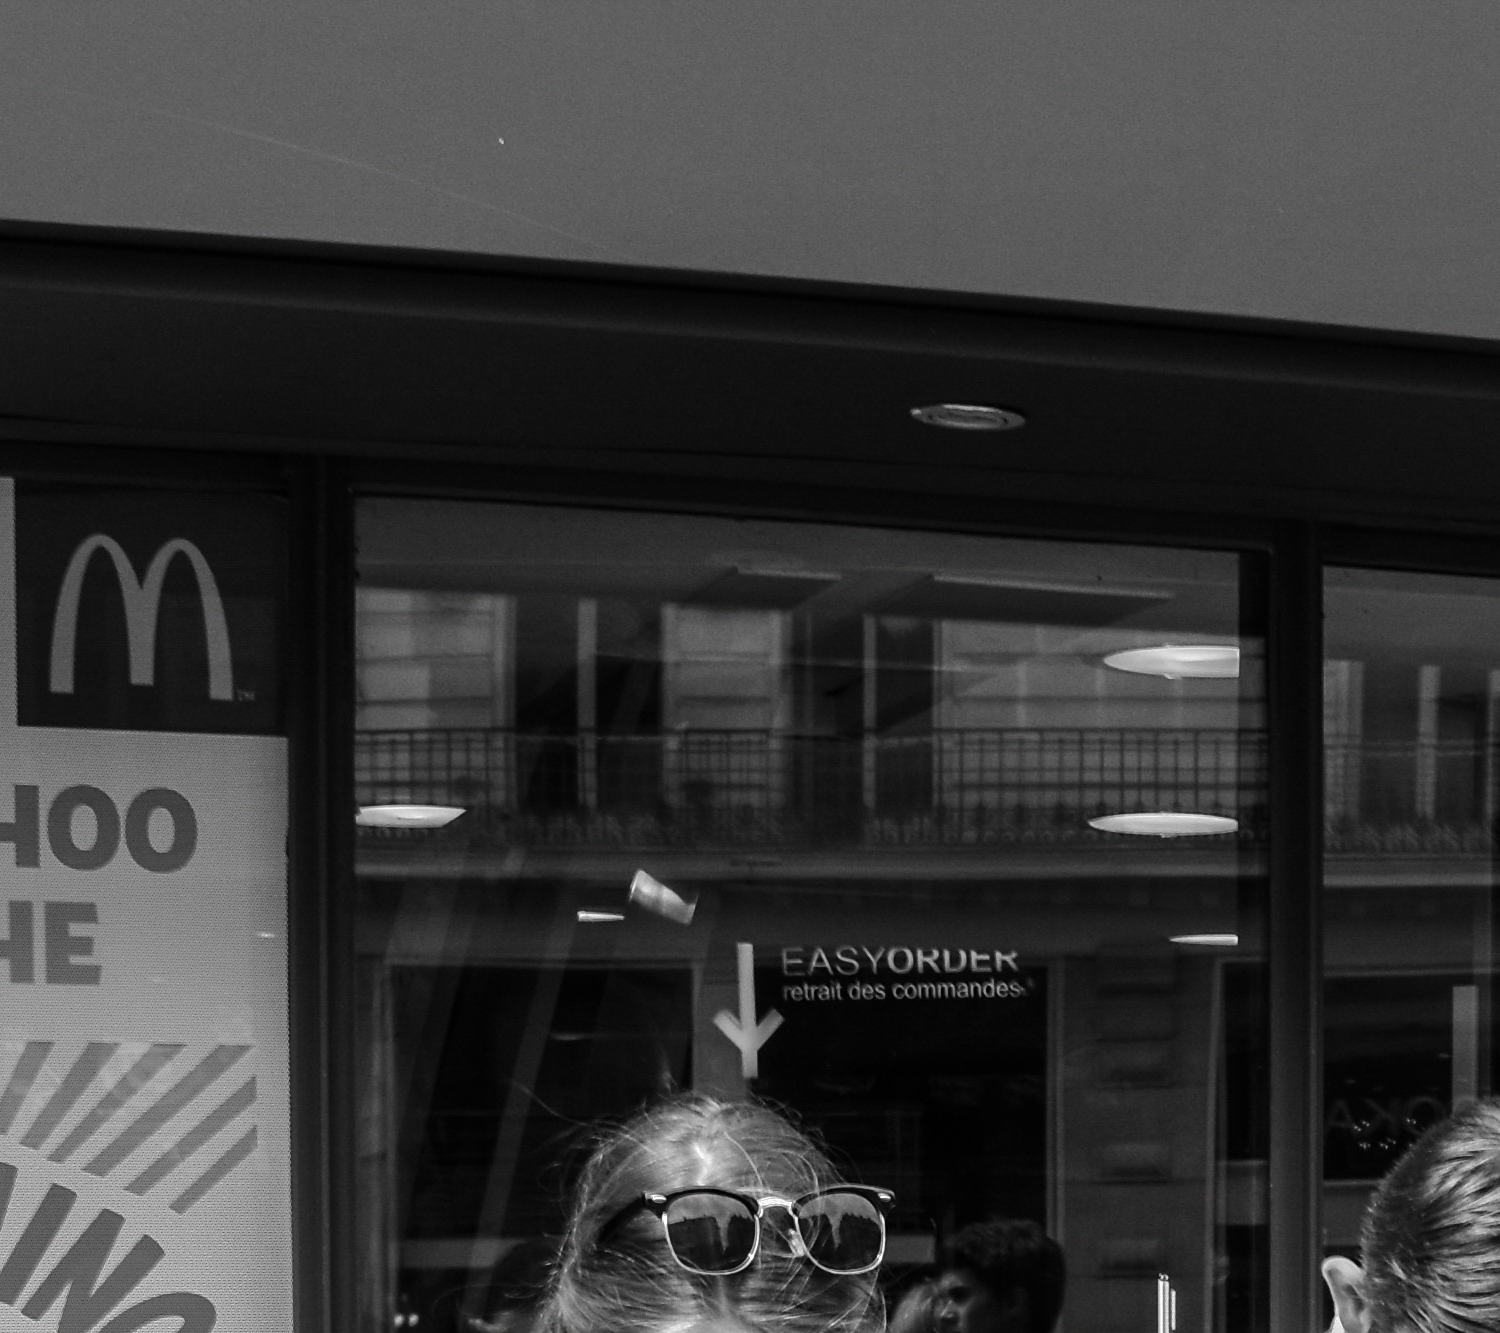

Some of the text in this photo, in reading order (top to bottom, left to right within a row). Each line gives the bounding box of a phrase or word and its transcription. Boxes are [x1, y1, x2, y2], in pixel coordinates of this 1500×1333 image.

[781, 945, 1020, 976] EASYORDER
[782, 978, 1020, 1001] retrait des commandes
